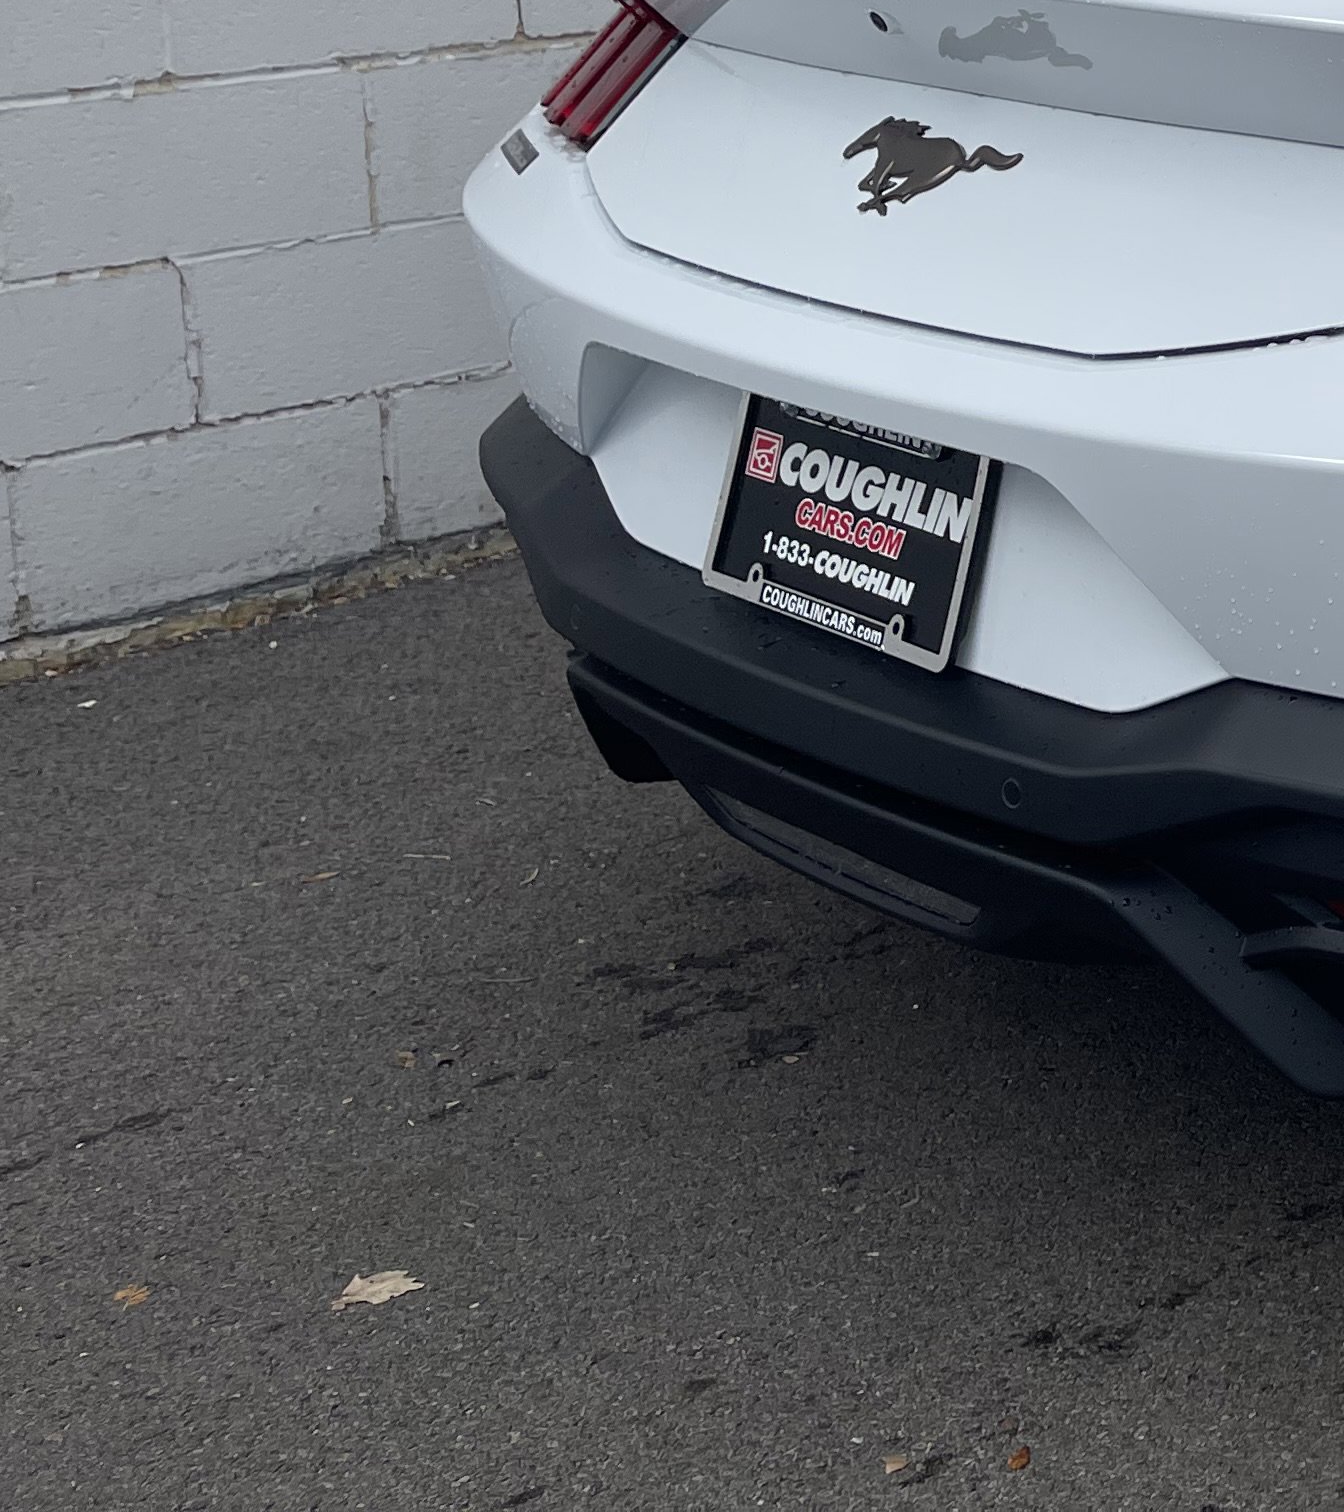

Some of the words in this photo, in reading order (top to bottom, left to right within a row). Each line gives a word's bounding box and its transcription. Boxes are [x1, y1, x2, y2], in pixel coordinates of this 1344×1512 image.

[779, 442, 974, 544] COUGHLIN
[795, 498, 906, 560] CARS.COM
[763, 530, 916, 607] 1-833-COUGHLIN
[761, 584, 884, 645] COUGHLINCARS.com
